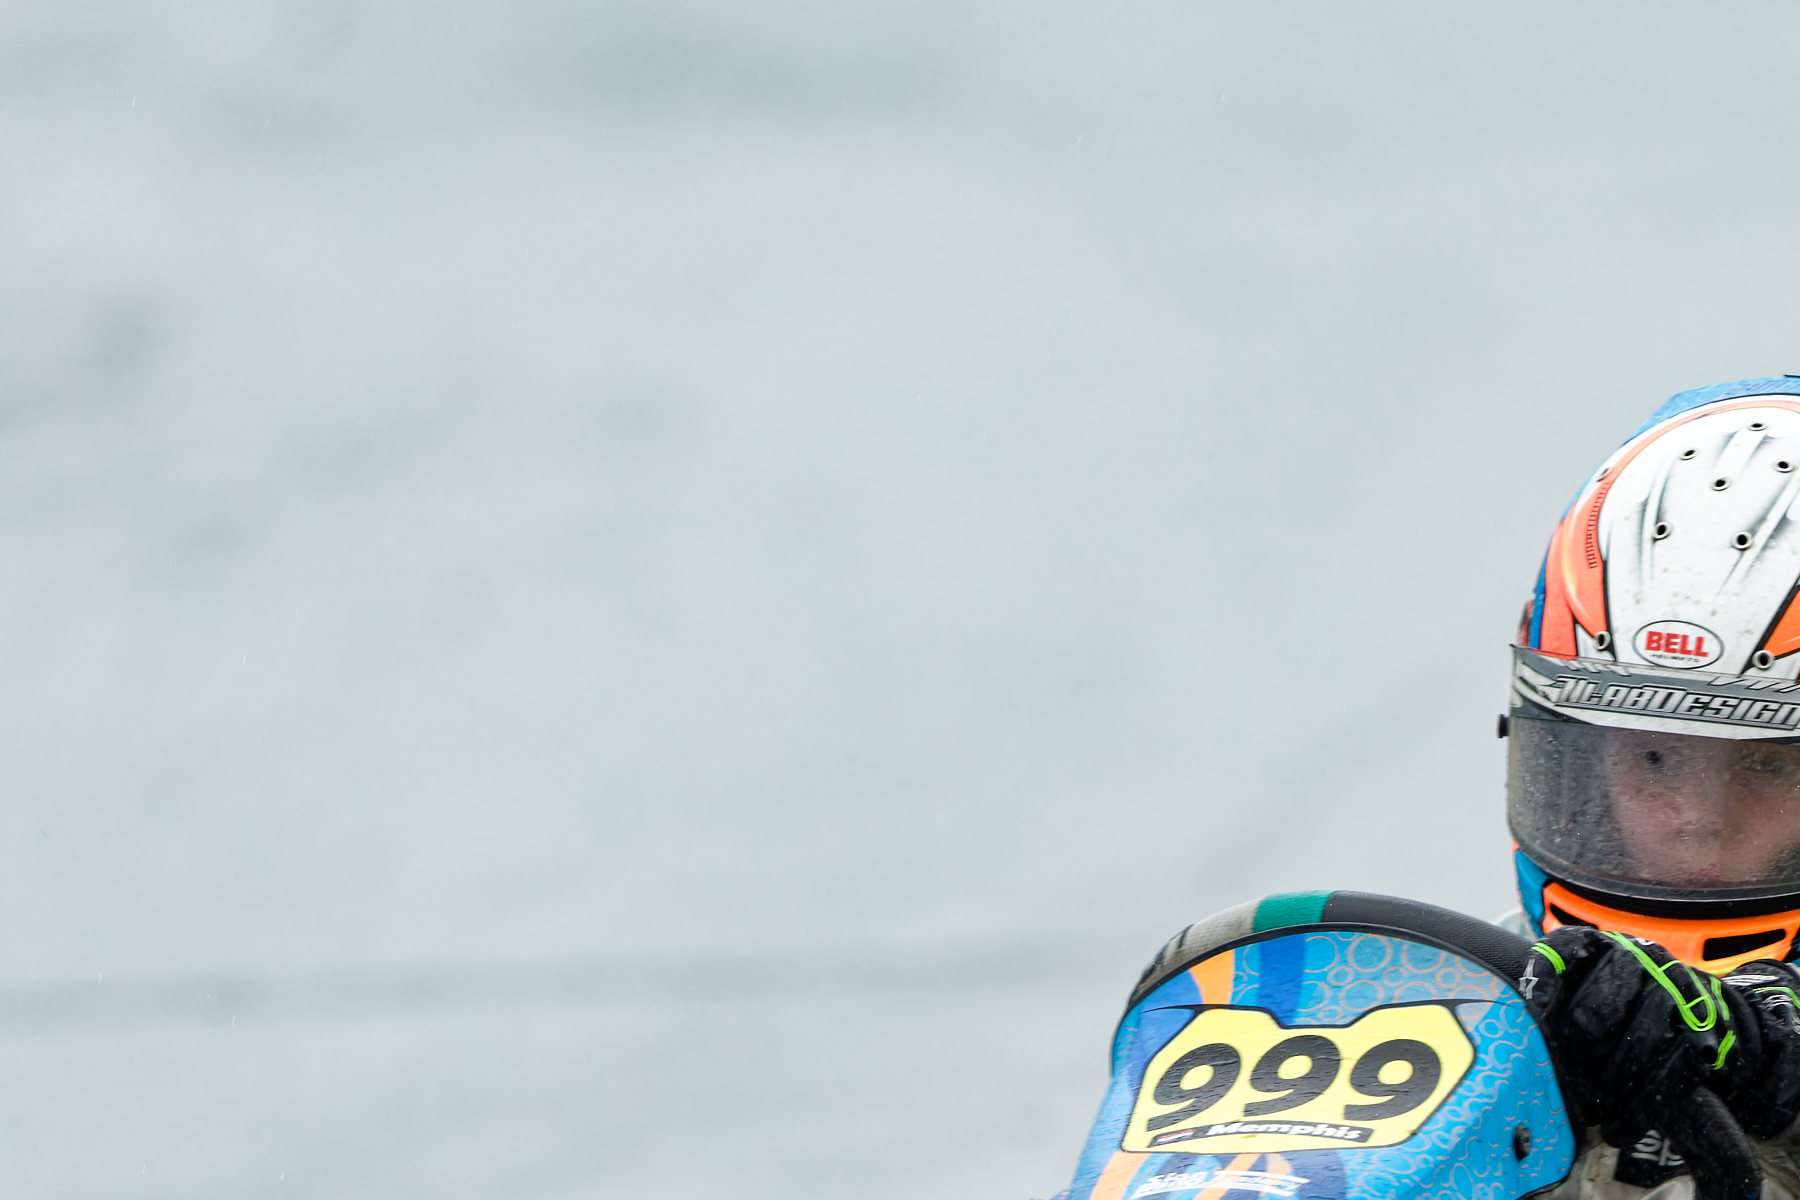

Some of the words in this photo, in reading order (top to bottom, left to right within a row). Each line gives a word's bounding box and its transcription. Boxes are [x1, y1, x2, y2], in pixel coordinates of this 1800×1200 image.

[1645, 631, 1709, 657] BELL
[1146, 1034, 1442, 1131] 999
[1206, 1121, 1362, 1140] Memphis
